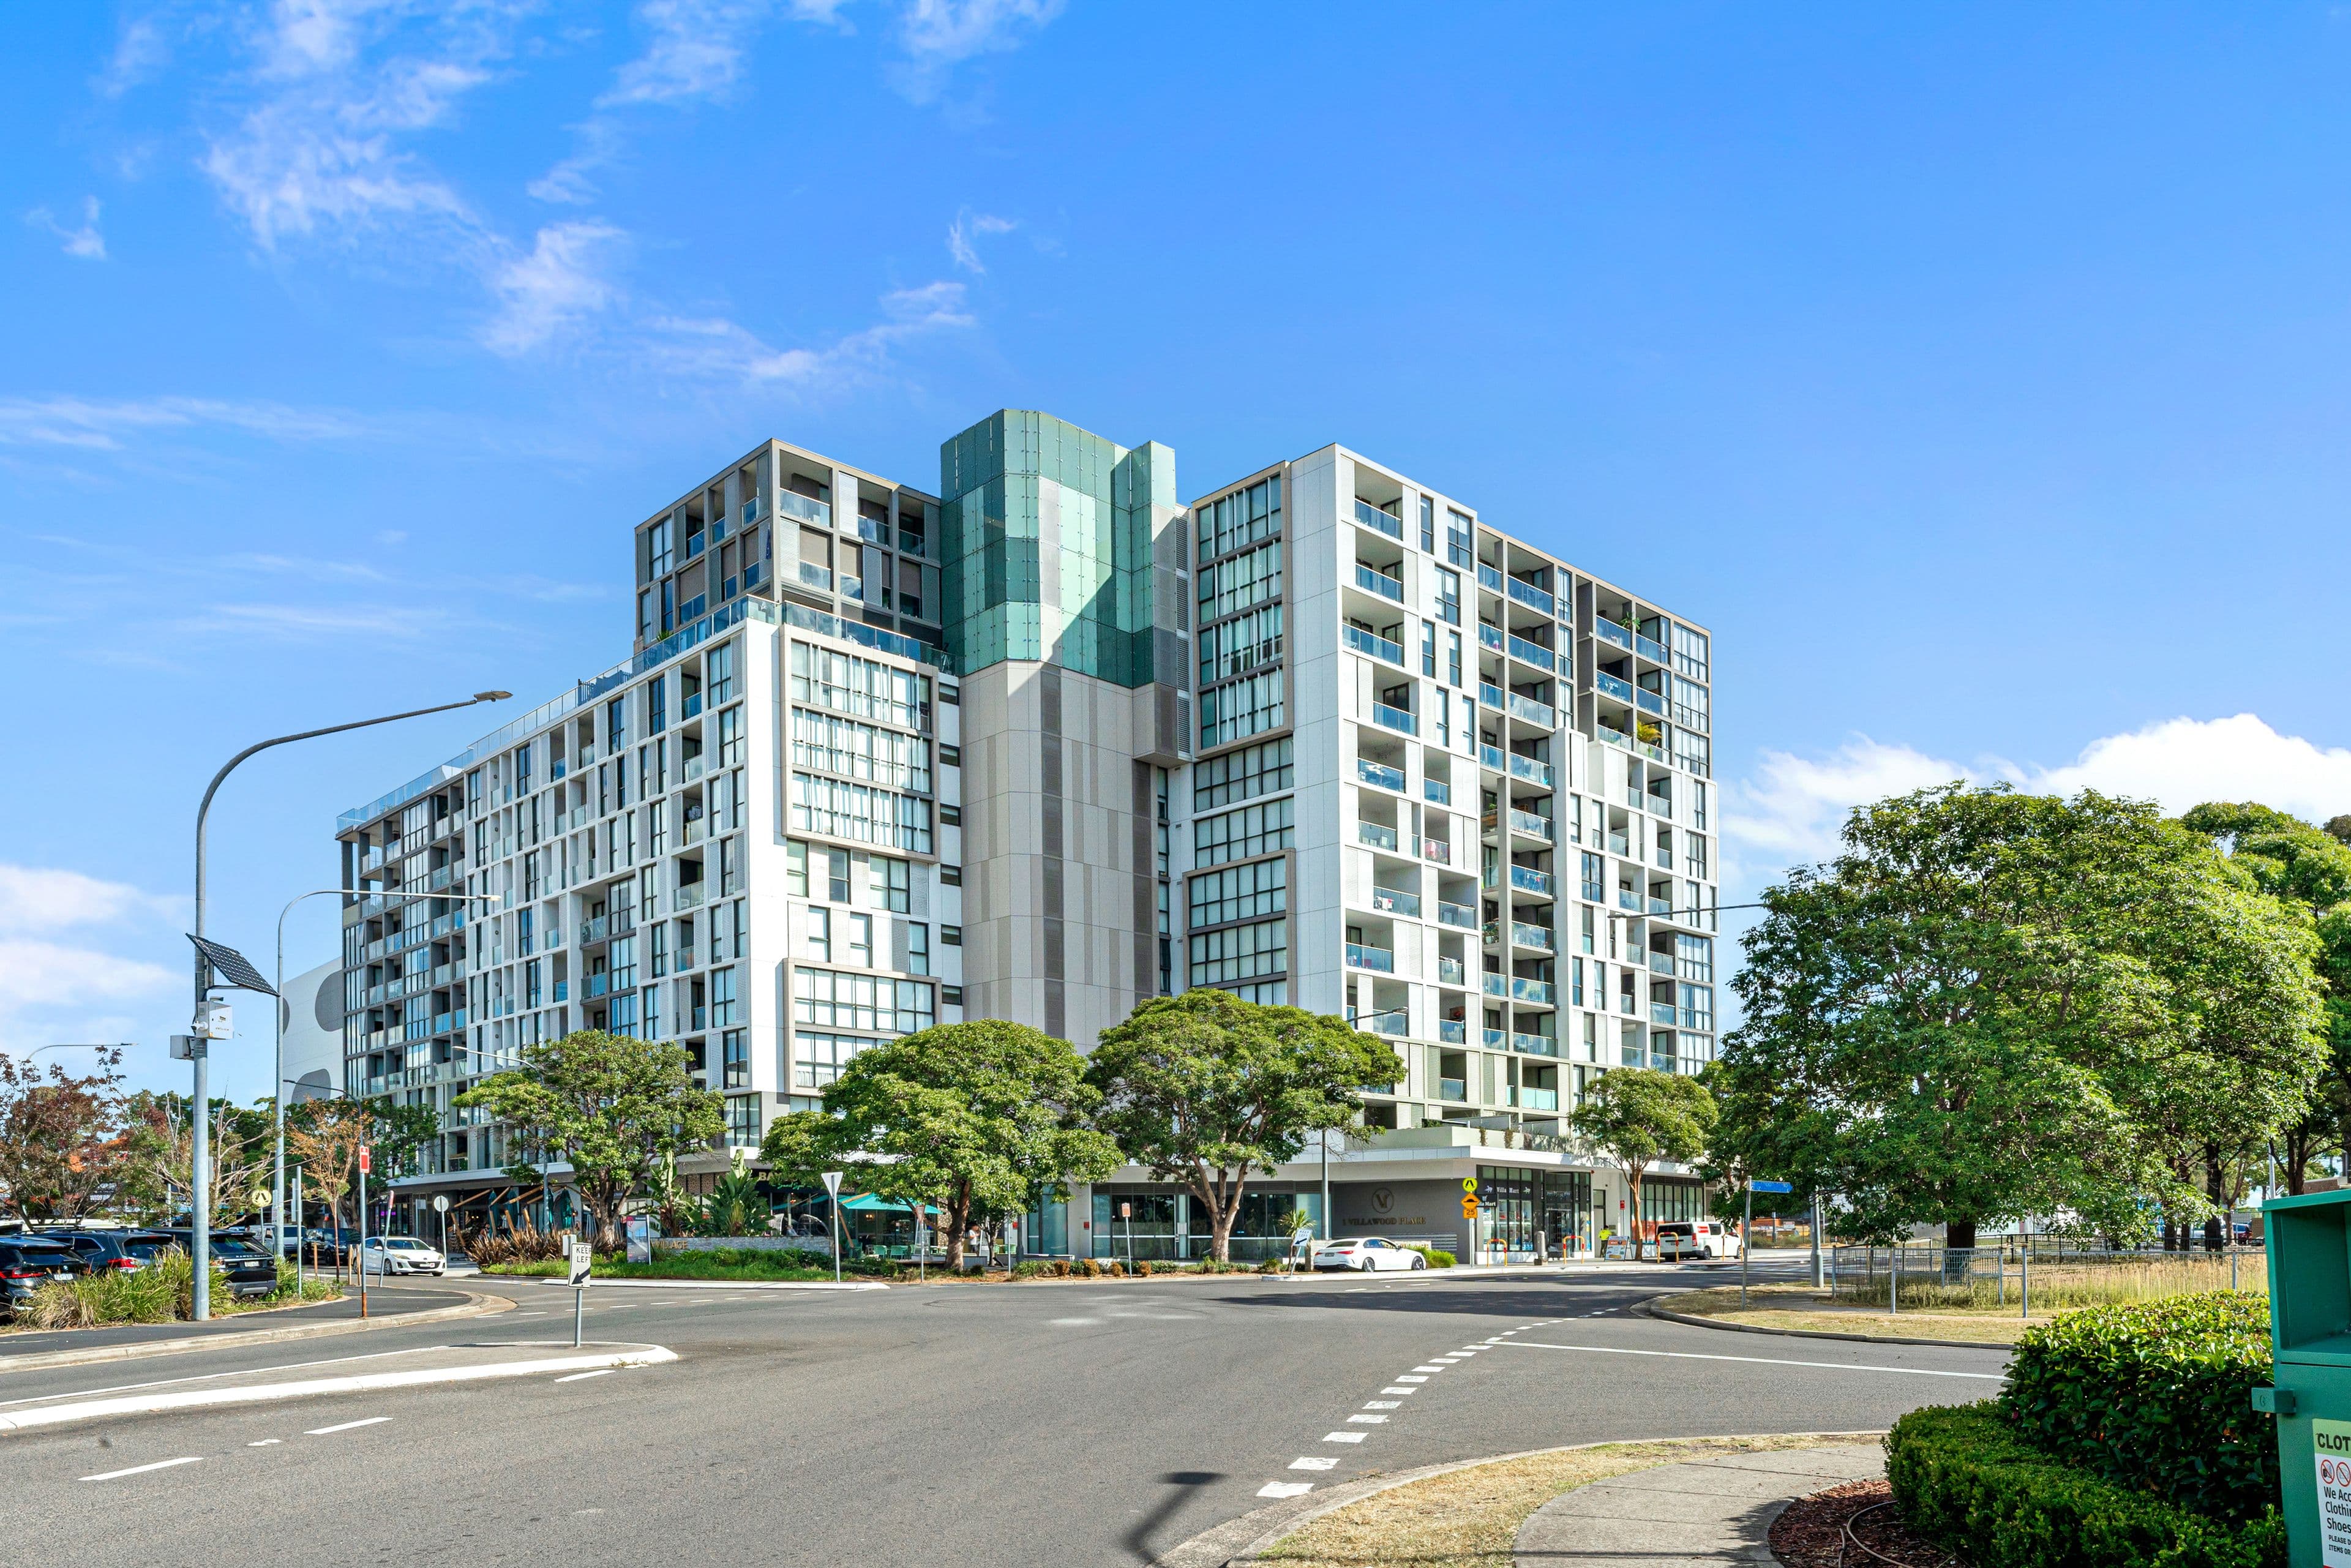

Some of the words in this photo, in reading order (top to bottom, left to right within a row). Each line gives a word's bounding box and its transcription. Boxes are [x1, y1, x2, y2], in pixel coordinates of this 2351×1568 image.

[1348, 1217, 1397, 1226] VILLAWOOD
[1399, 1217, 1426, 1225] PLACE
[2317, 1433, 2351, 1452] CLOT
[2323, 1486, 2336, 1499] We
[2338, 1489, 2351, 1502] Acc
[2327, 1517, 2351, 1534] Shoes
[2328, 1534, 2347, 1545] PLEASE
[2328, 1544, 2343, 1554] ITEMS
